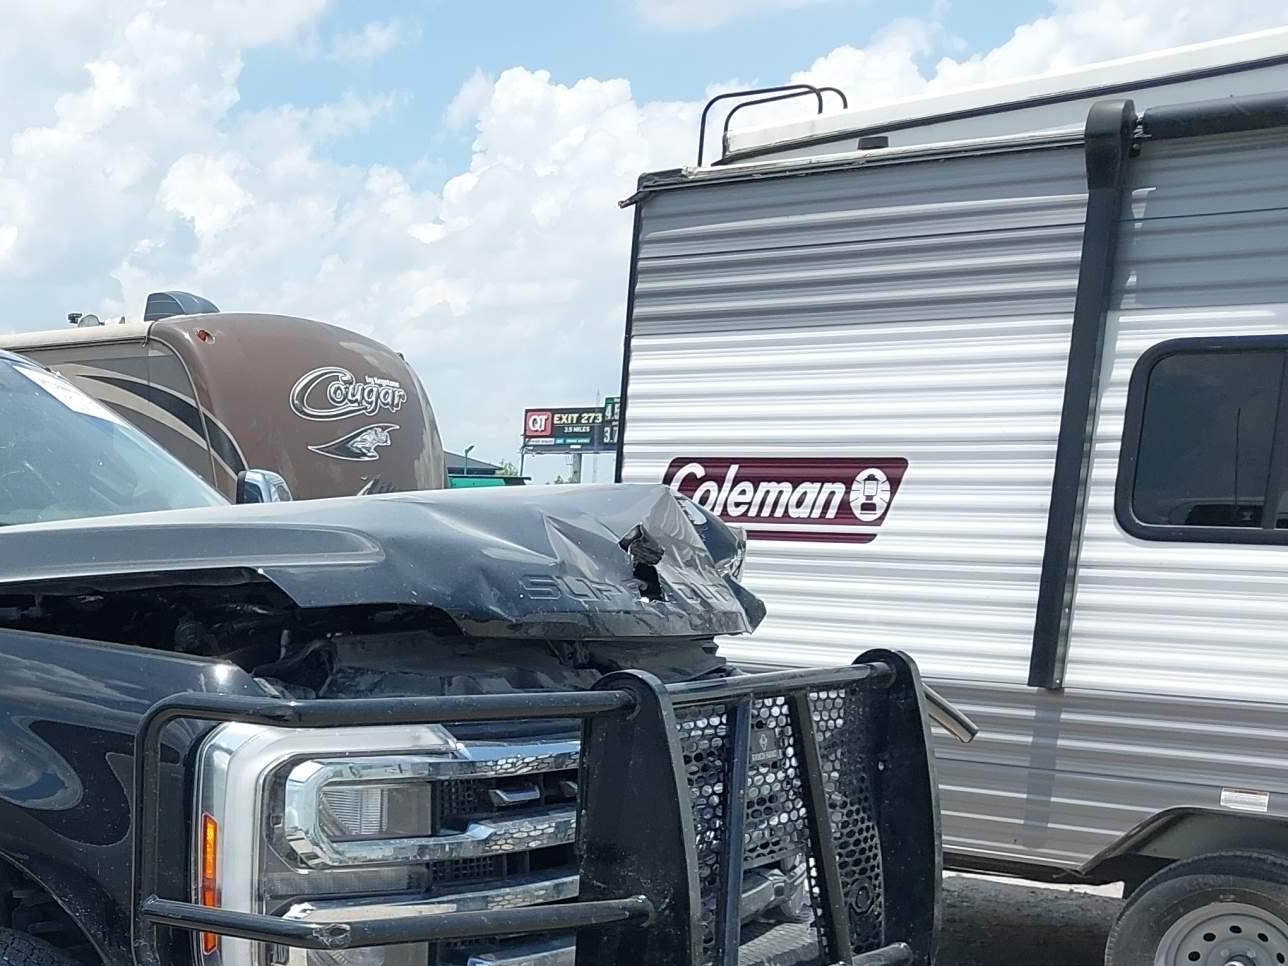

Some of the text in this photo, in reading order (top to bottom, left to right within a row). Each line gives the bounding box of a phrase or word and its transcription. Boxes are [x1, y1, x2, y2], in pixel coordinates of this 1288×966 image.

[289, 366, 408, 421] Cougar
[528, 414, 548, 432] QT
[553, 412, 603, 425] EXIT 273
[669, 462, 847, 519] Coleman
